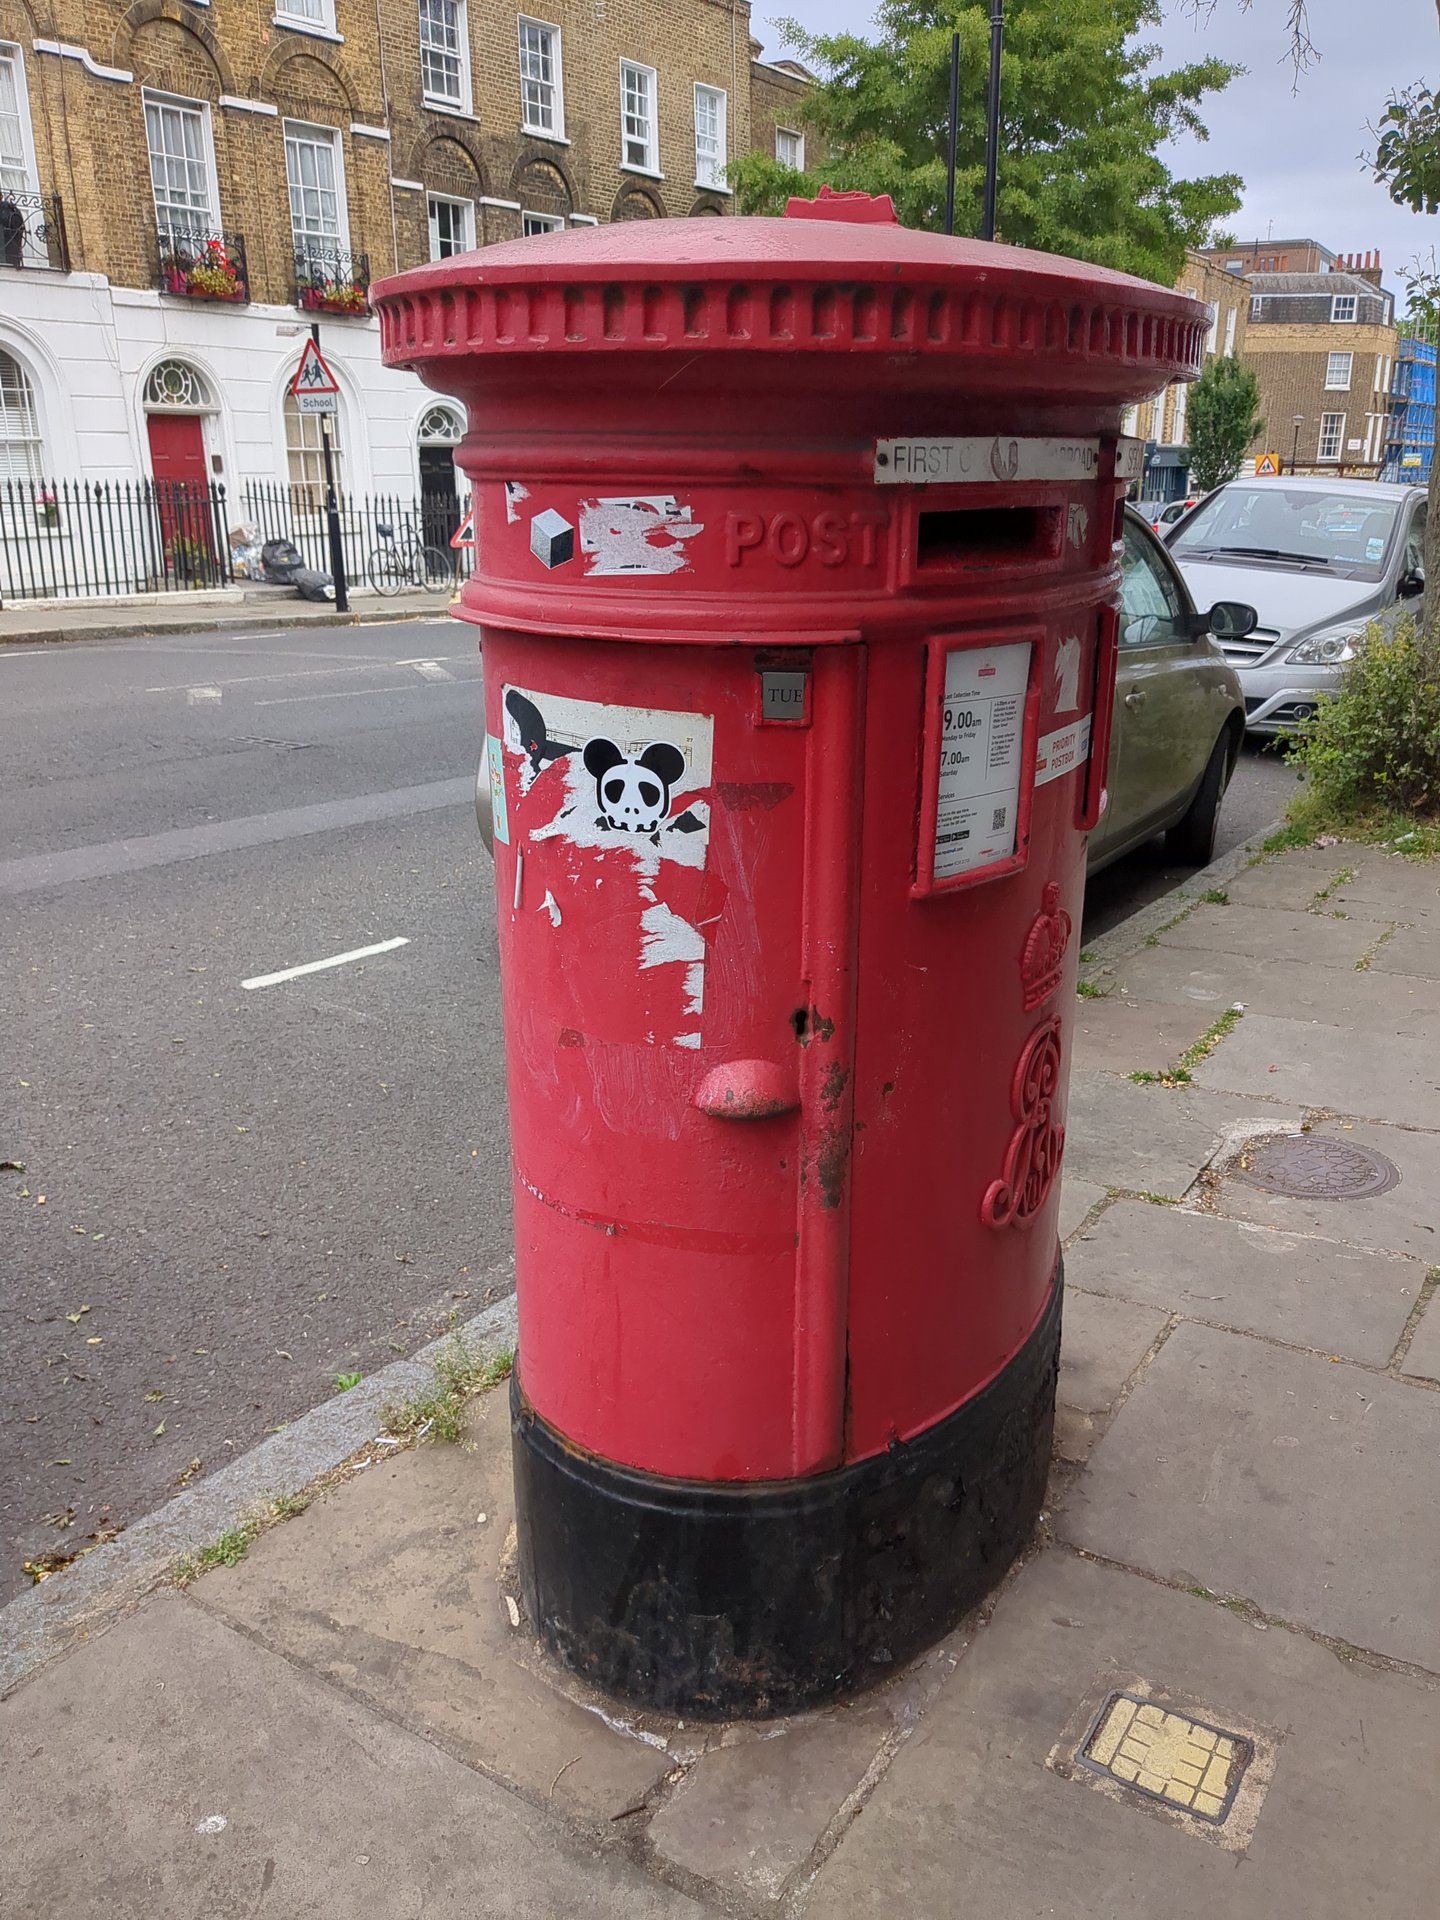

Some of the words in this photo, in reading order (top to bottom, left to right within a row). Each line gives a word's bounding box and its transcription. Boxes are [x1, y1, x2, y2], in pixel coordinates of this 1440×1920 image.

[303, 398, 333, 408] School
[894, 446, 953, 473] FIRST
[725, 511, 888, 569] POST
[768, 688, 803, 703] TUE
[953, 691, 971, 699] Collection
[944, 709, 982, 731] 9.00am
[964, 731, 976, 740] Friday
[1052, 733, 1075, 754] PRIORITY
[941, 751, 970, 767] 7.00am
[1050, 750, 1075, 771] POSTBOX
